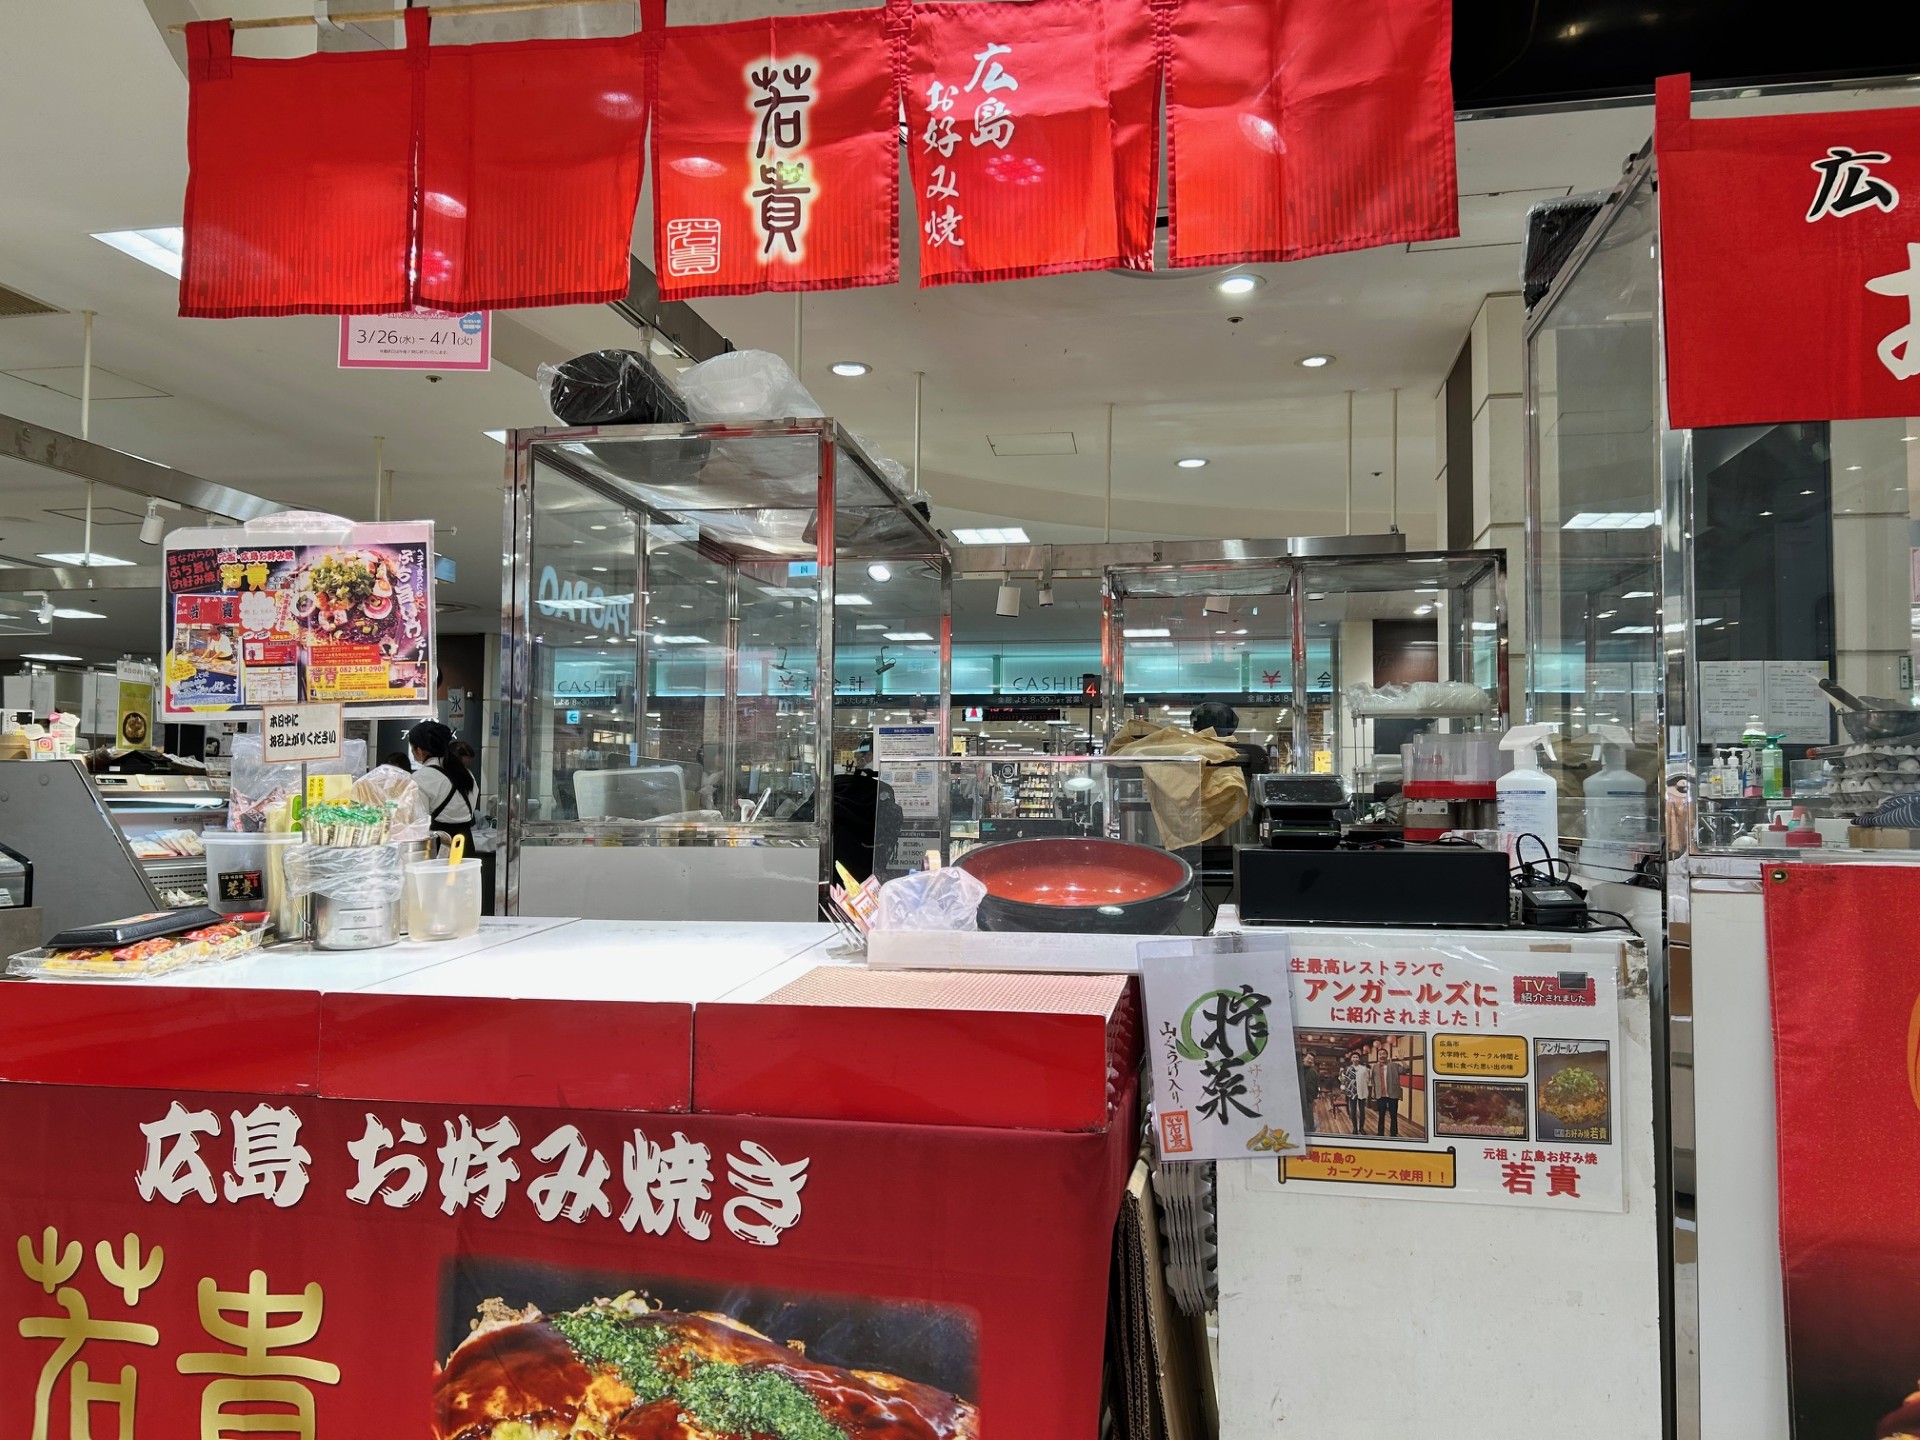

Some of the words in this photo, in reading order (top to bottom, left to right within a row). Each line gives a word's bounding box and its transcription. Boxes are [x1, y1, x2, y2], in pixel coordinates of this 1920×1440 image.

[964, 43, 1018, 149] 広島
[751, 64, 811, 255] 若貴
[923, 81, 964, 248] お好み焼
[1086, 682, 1097, 697] 4
[269, 713, 299, 728] 本日中に
[269, 730, 336, 748] お召上がりください
[1303, 978, 1499, 1008] アンガールズに
[1520, 992, 1586, 1003] 紹介されました
[1540, 1043, 1580, 1054] アンガールズ
[1483, 1147, 1599, 1165] 元祖・広島お好み焼
[135, 1100, 312, 1208] 広島
[346, 1113, 811, 1247] お好み焼き
[1501, 1161, 1581, 1199] 若貴
